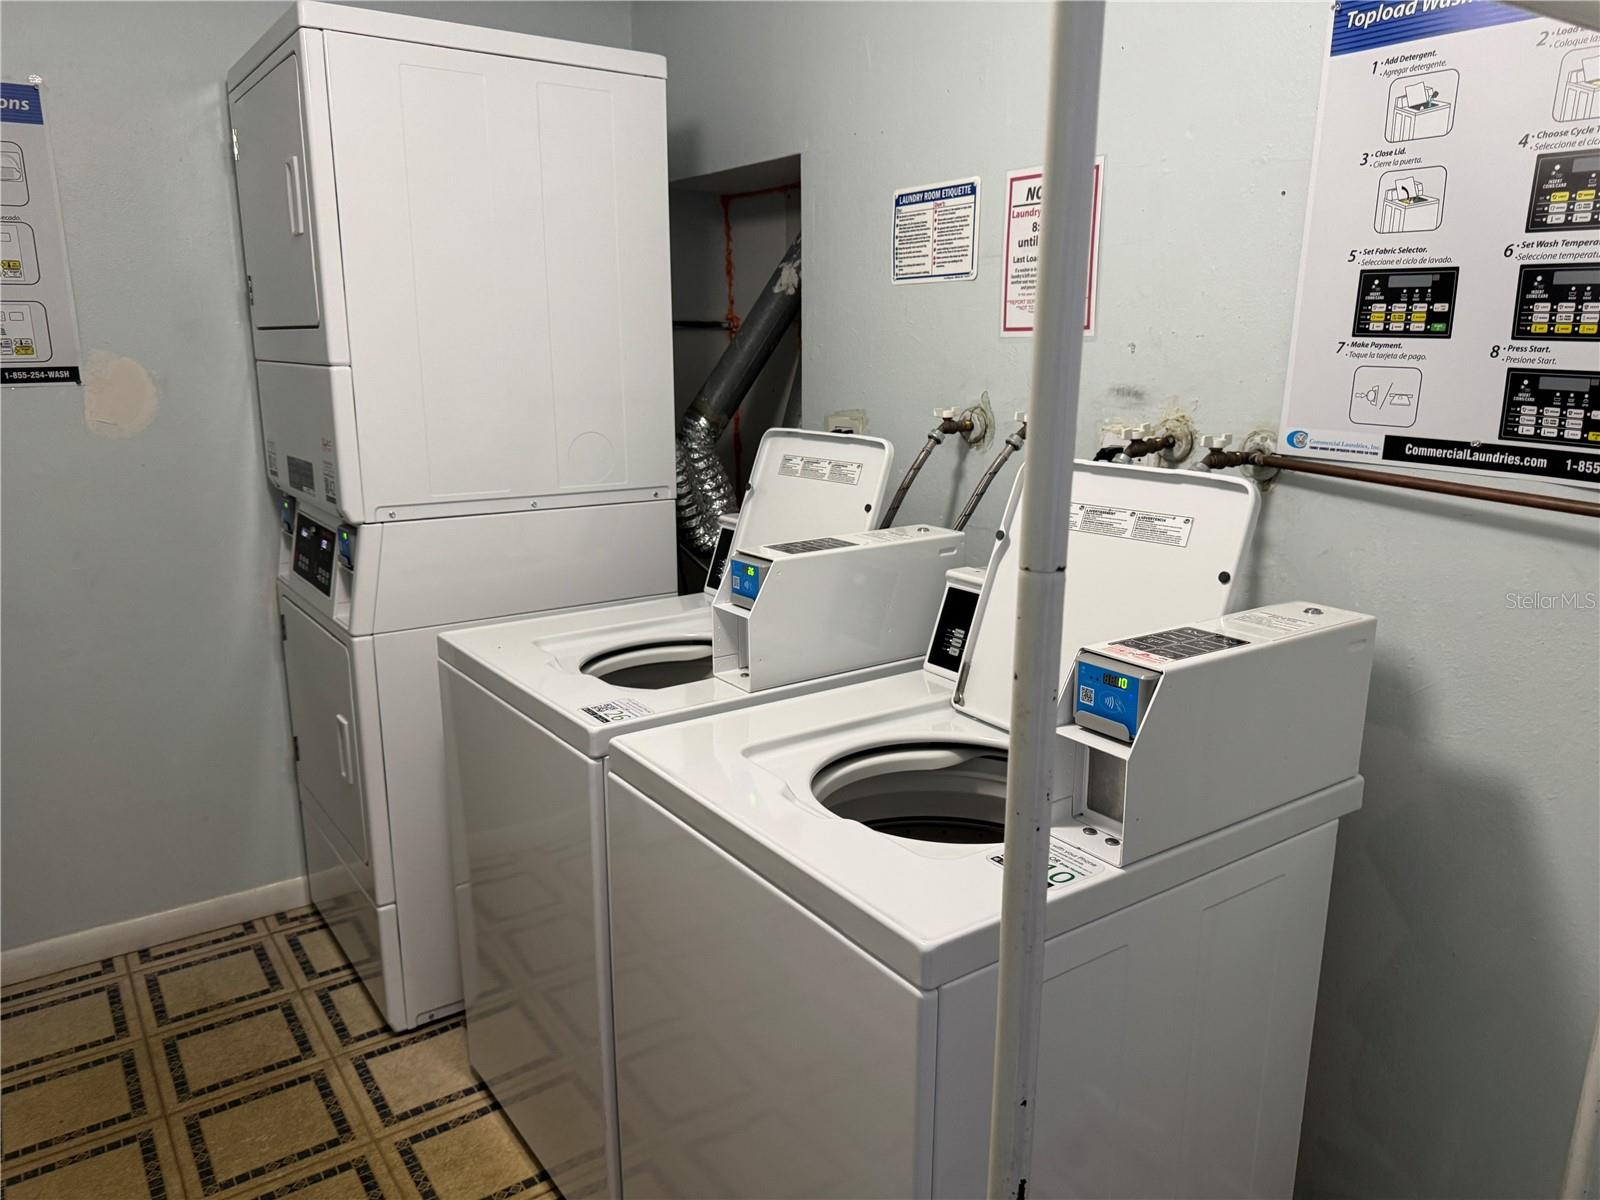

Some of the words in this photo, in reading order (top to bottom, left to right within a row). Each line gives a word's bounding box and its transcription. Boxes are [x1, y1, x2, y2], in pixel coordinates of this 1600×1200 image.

[1347, 0, 1418, 29] Topload
[1536, 31, 1549, 47] 2
[1554, 36, 1589, 48] Coloque
[1372, 61, 1378, 75] 1
[1385, 56, 1398, 65] Add
[1400, 50, 1437, 63] Detergent.
[1383, 66, 1408, 78] Agregar
[1410, 60, 1447, 73] detergente.
[1518, 133, 1530, 148] 4
[1537, 130, 1569, 139] Choose
[1571, 126, 1594, 137] Cycle
[1534, 140, 1577, 151] Seleccione
[1578, 138, 1586, 146] el
[1360, 153, 1369, 166] 3
[1375, 150, 1393, 158] Close
[1394, 147, 1406, 156] Lid.
[1373, 160, 1392, 168] Cierre
[1392, 159, 1398, 167] la
[1400, 157, 1422, 167] puerta.
[900, 193, 923, 205] LAUNDRY
[924, 190, 941, 201] ROOM
[942, 185, 972, 198] ETIQUETTE
[1018, 235, 1039, 248] until
[1347, 249, 1357, 263] 5
[1375, 247, 1397, 255] Fabric
[1398, 246, 1428, 254] Selector.
[1504, 243, 1515, 258] 6
[1521, 241, 1534, 249] Set
[1536, 240, 1559, 248] Wash
[1561, 239, 1600, 248] Tempera
[1013, 256, 1026, 264] Last
[1361, 258, 1395, 266] Seleccione
[1396, 257, 1401, 265] el
[1402, 257, 1418, 265] ciclo
[1428, 256, 1453, 264] lavado.
[1517, 252, 1557, 261] Seleccione
[1336, 342, 1346, 354] 7
[1350, 341, 1369, 349] Make
[1370, 342, 1403, 350] Payment.
[1490, 345, 1500, 358] 8
[1507, 344, 1528, 353] Press
[1529, 345, 1551, 353] Start.
[1349, 351, 1368, 360] Toque
[1376, 352, 1398, 360] tarjeta
[1399, 352, 1407, 360] de
[1407, 353, 1427, 361] pago.
[1505, 355, 1536, 364] Presione
[1537, 356, 1557, 365] Start.
[4, 370, 70, 379] 1-855-254-WASH
[1405, 443, 1548, 468] CommercialLaundries.com
